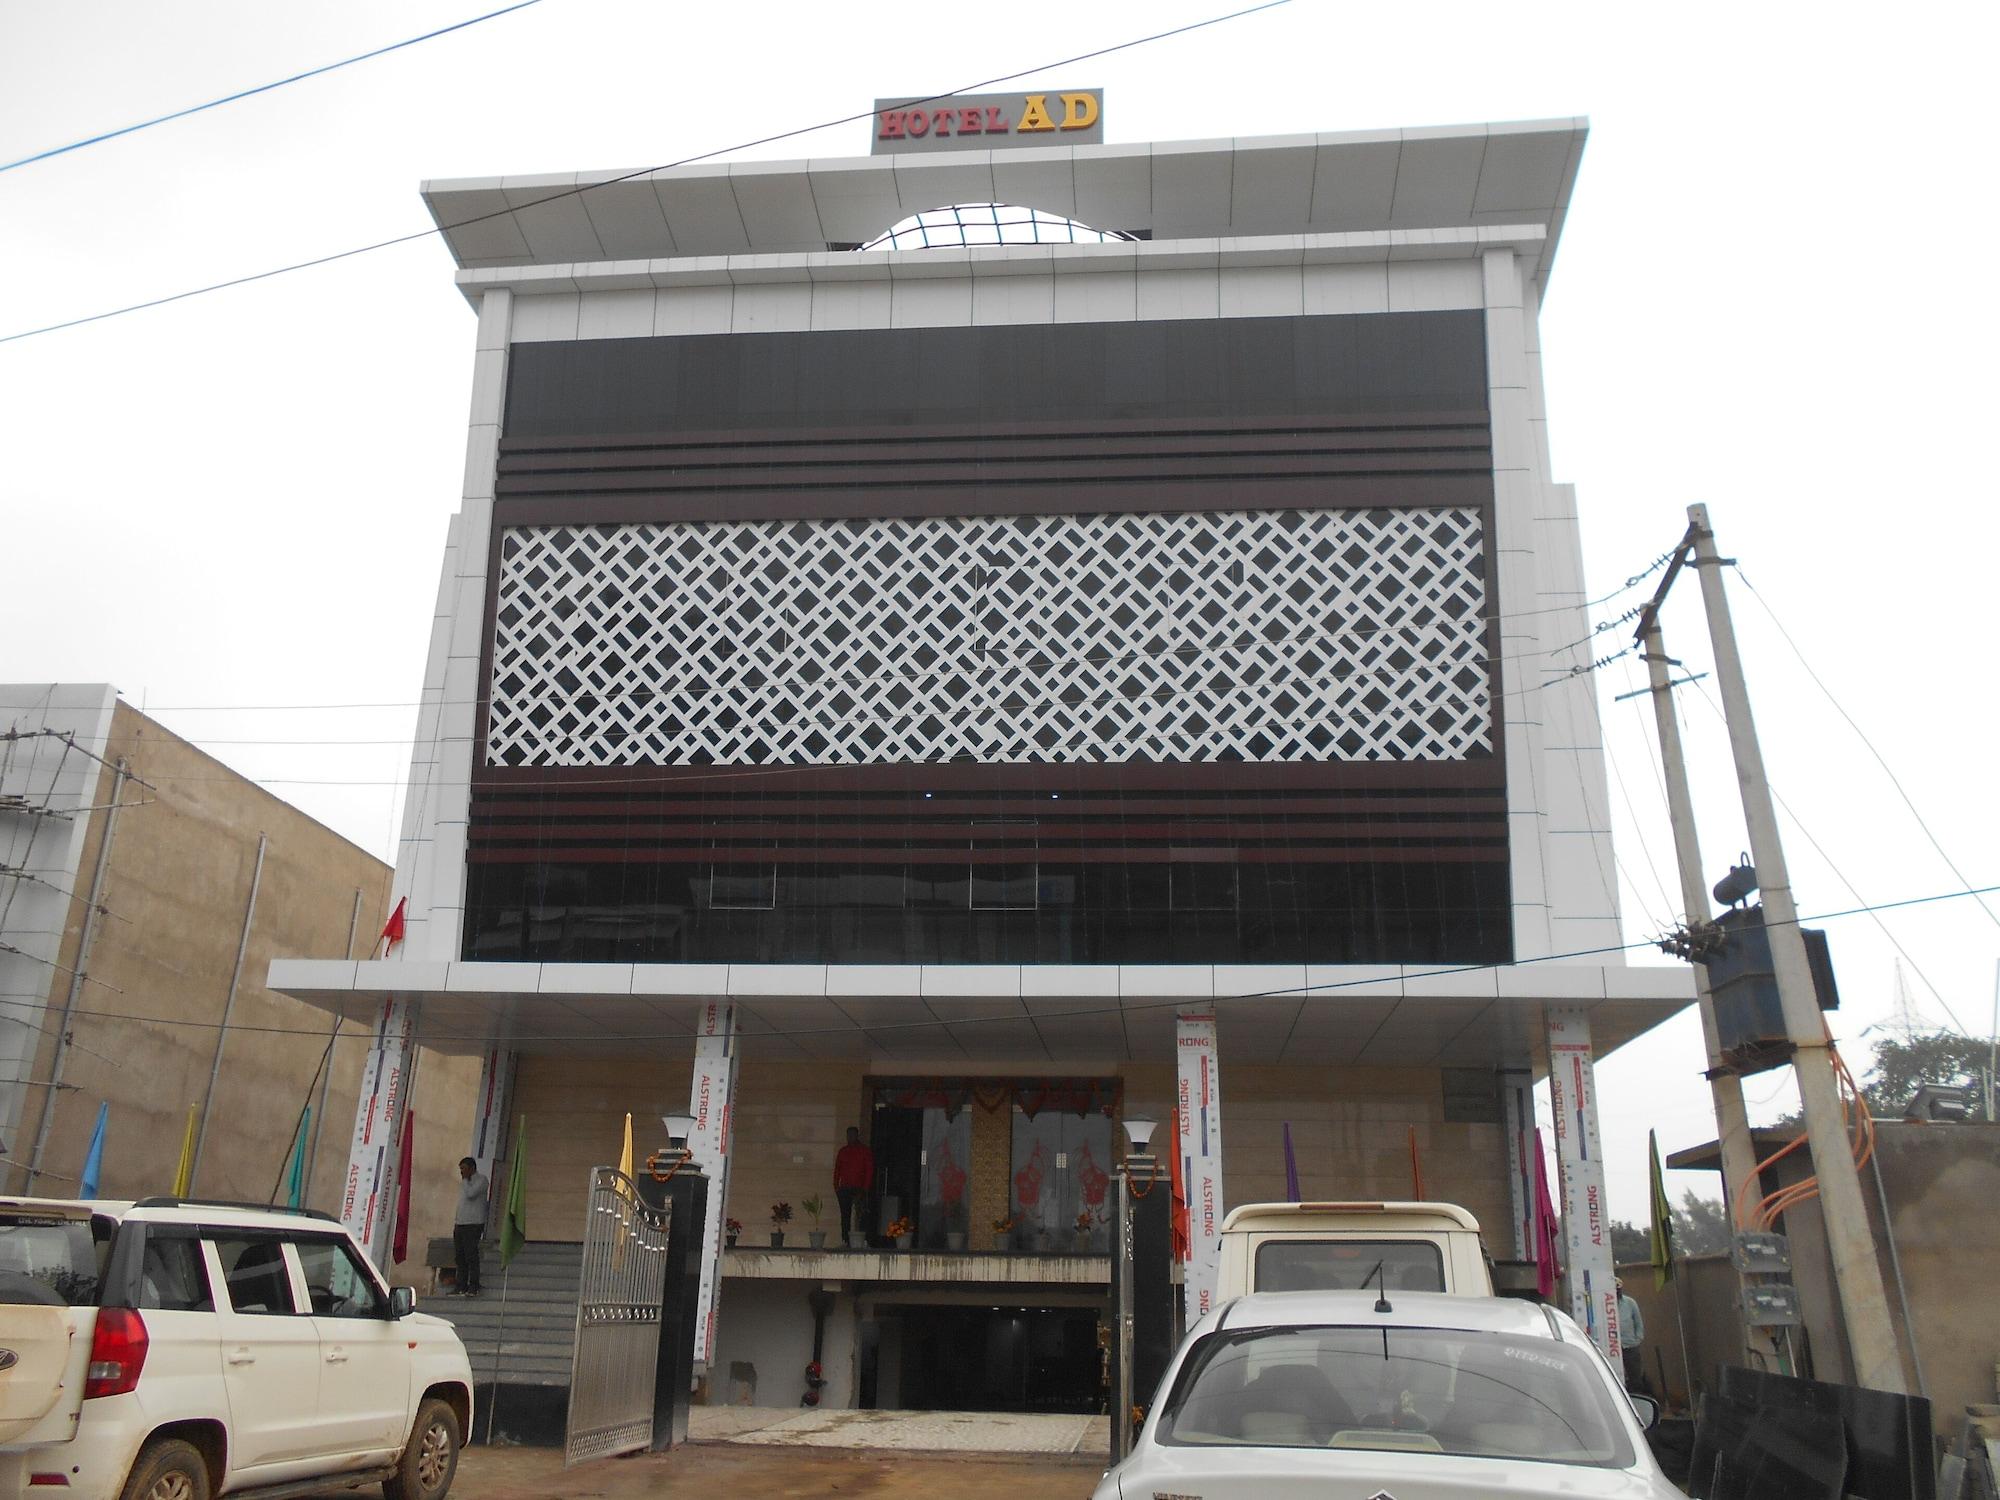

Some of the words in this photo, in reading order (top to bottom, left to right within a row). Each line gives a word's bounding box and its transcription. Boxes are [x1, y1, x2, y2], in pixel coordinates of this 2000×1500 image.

[878, 106, 1009, 140] HOTEL
[384, 1067, 400, 1123] ALSTRONG
[697, 1074, 711, 1131] ALSTRONG
[1180, 1078, 1191, 1137] ALSTRONG
[342, 1164, 360, 1223] ALSTRONG
[1203, 1176, 1214, 1238] ALSTRONG
[1587, 1185, 1602, 1247] ALSTRONG
[1604, 1292, 1620, 1358] ALSTRONG
